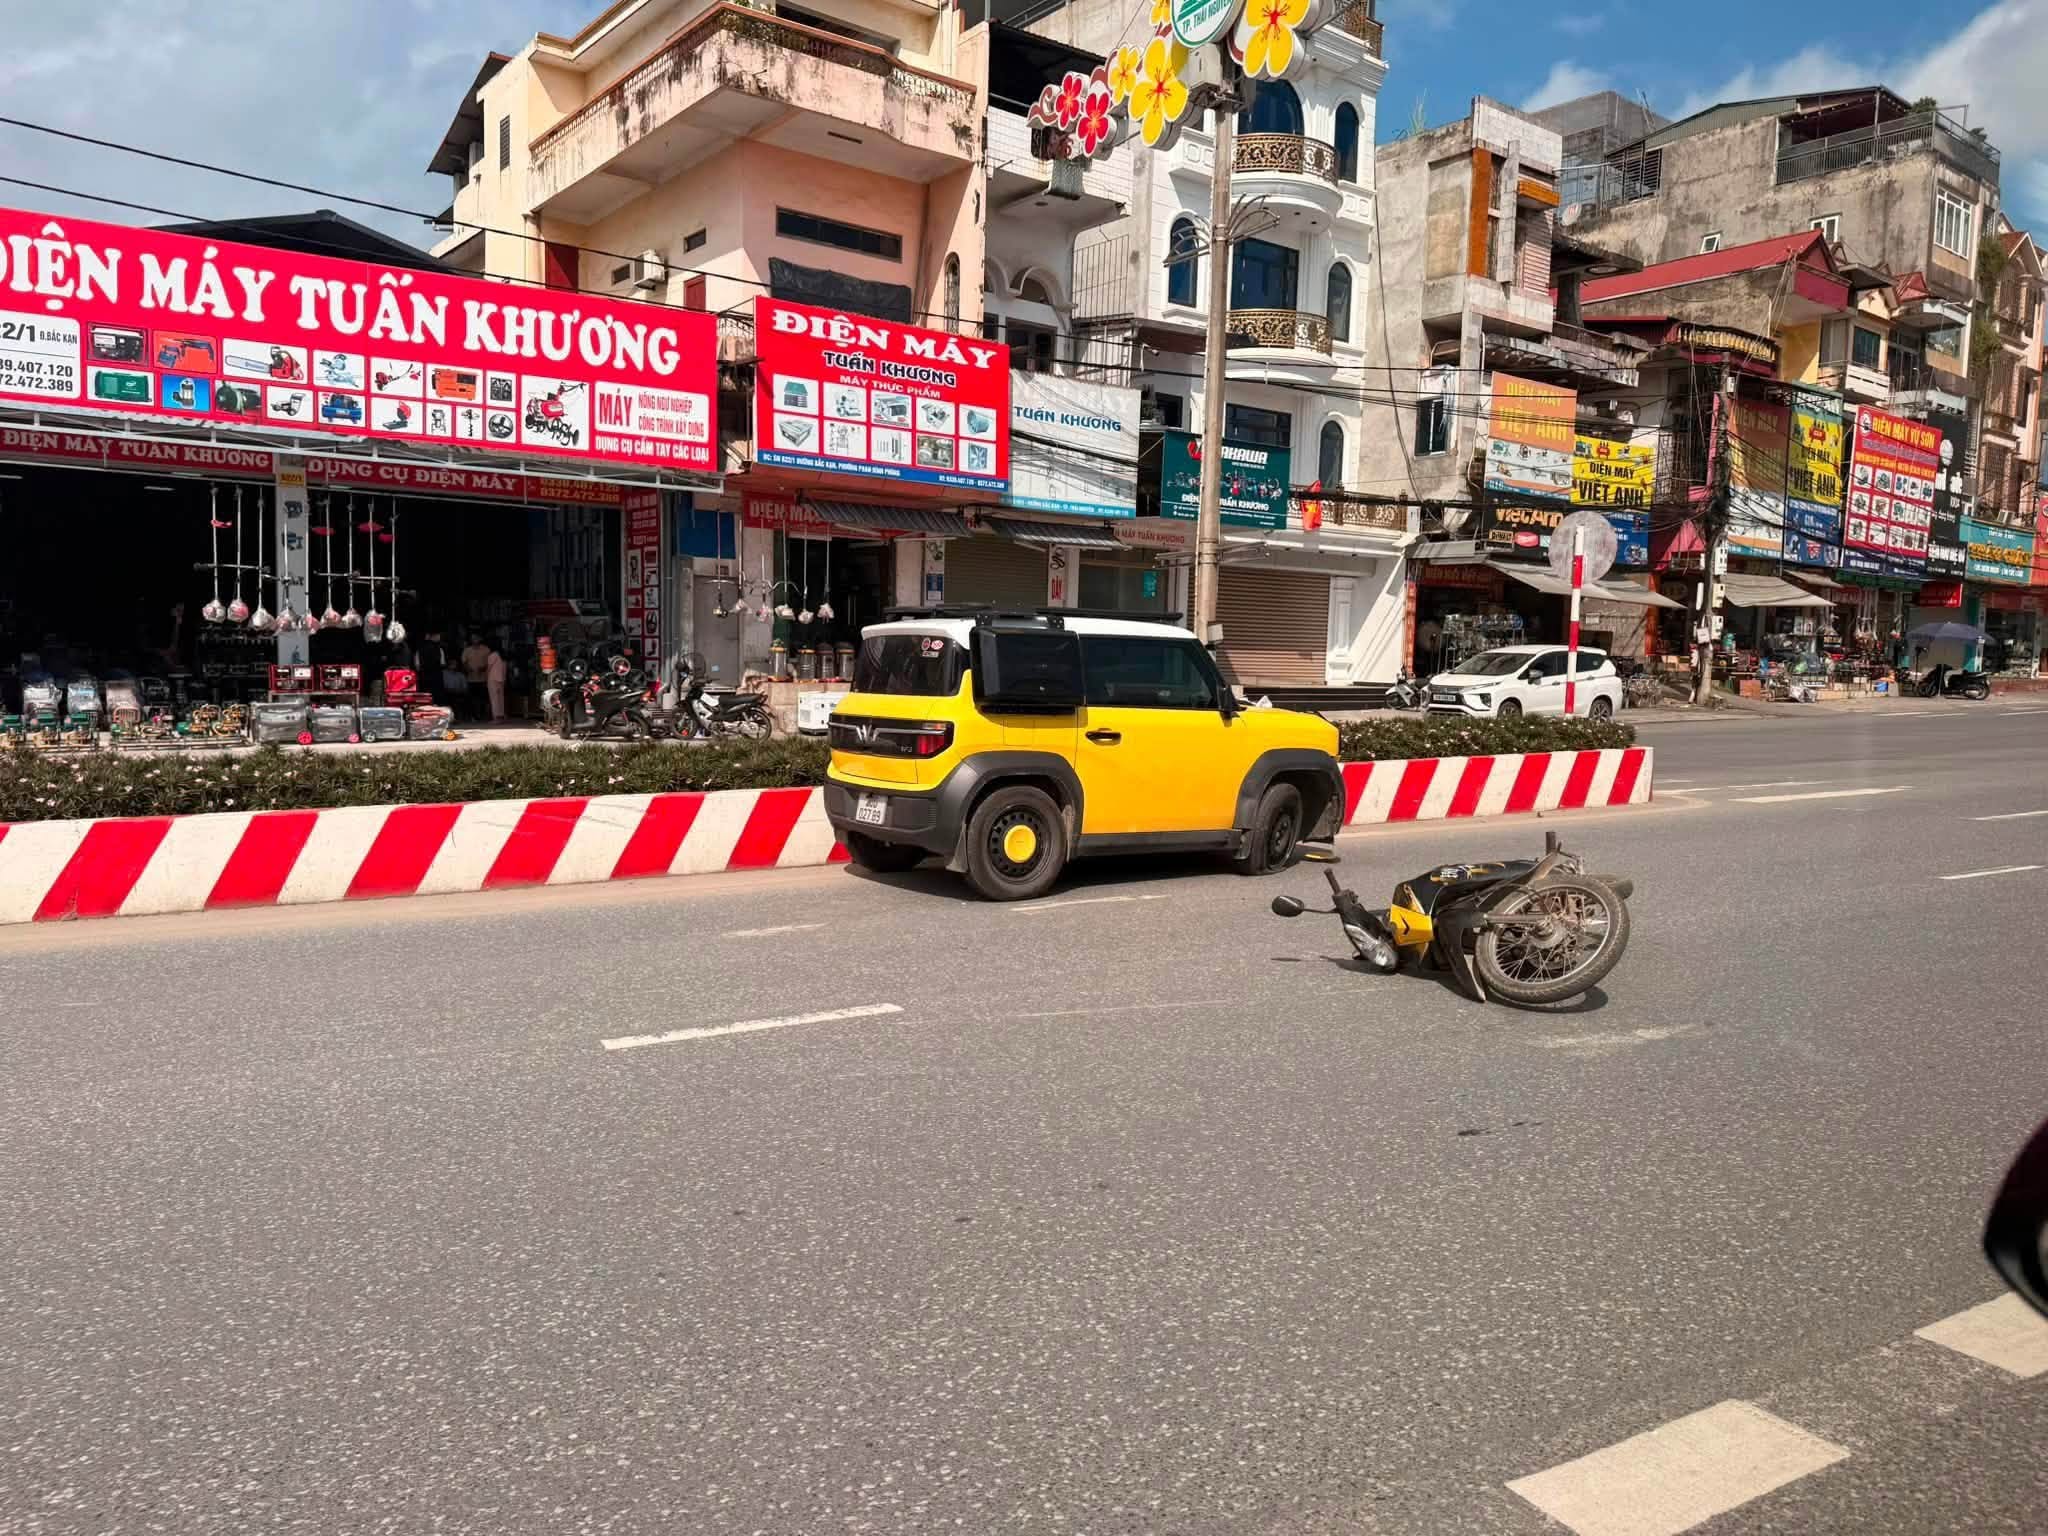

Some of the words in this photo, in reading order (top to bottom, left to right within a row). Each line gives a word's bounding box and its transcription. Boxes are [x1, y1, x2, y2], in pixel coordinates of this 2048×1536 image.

[0, 221, 122, 311] IỆN
[138, 245, 276, 323] MÁY
[288, 271, 449, 347] TUẤN
[462, 299, 681, 376] KHƯƠNG
[0, 322, 36, 342] 2/1
[772, 309, 890, 349] ĐIỆN
[903, 334, 997, 369] MÁY
[823, 351, 874, 373] TUẤN
[881, 361, 957, 387] KHƯƠNG
[840, 374, 867, 388] MÁY
[599, 388, 633, 427] MÁY
[655, 442, 671, 458] TAY
